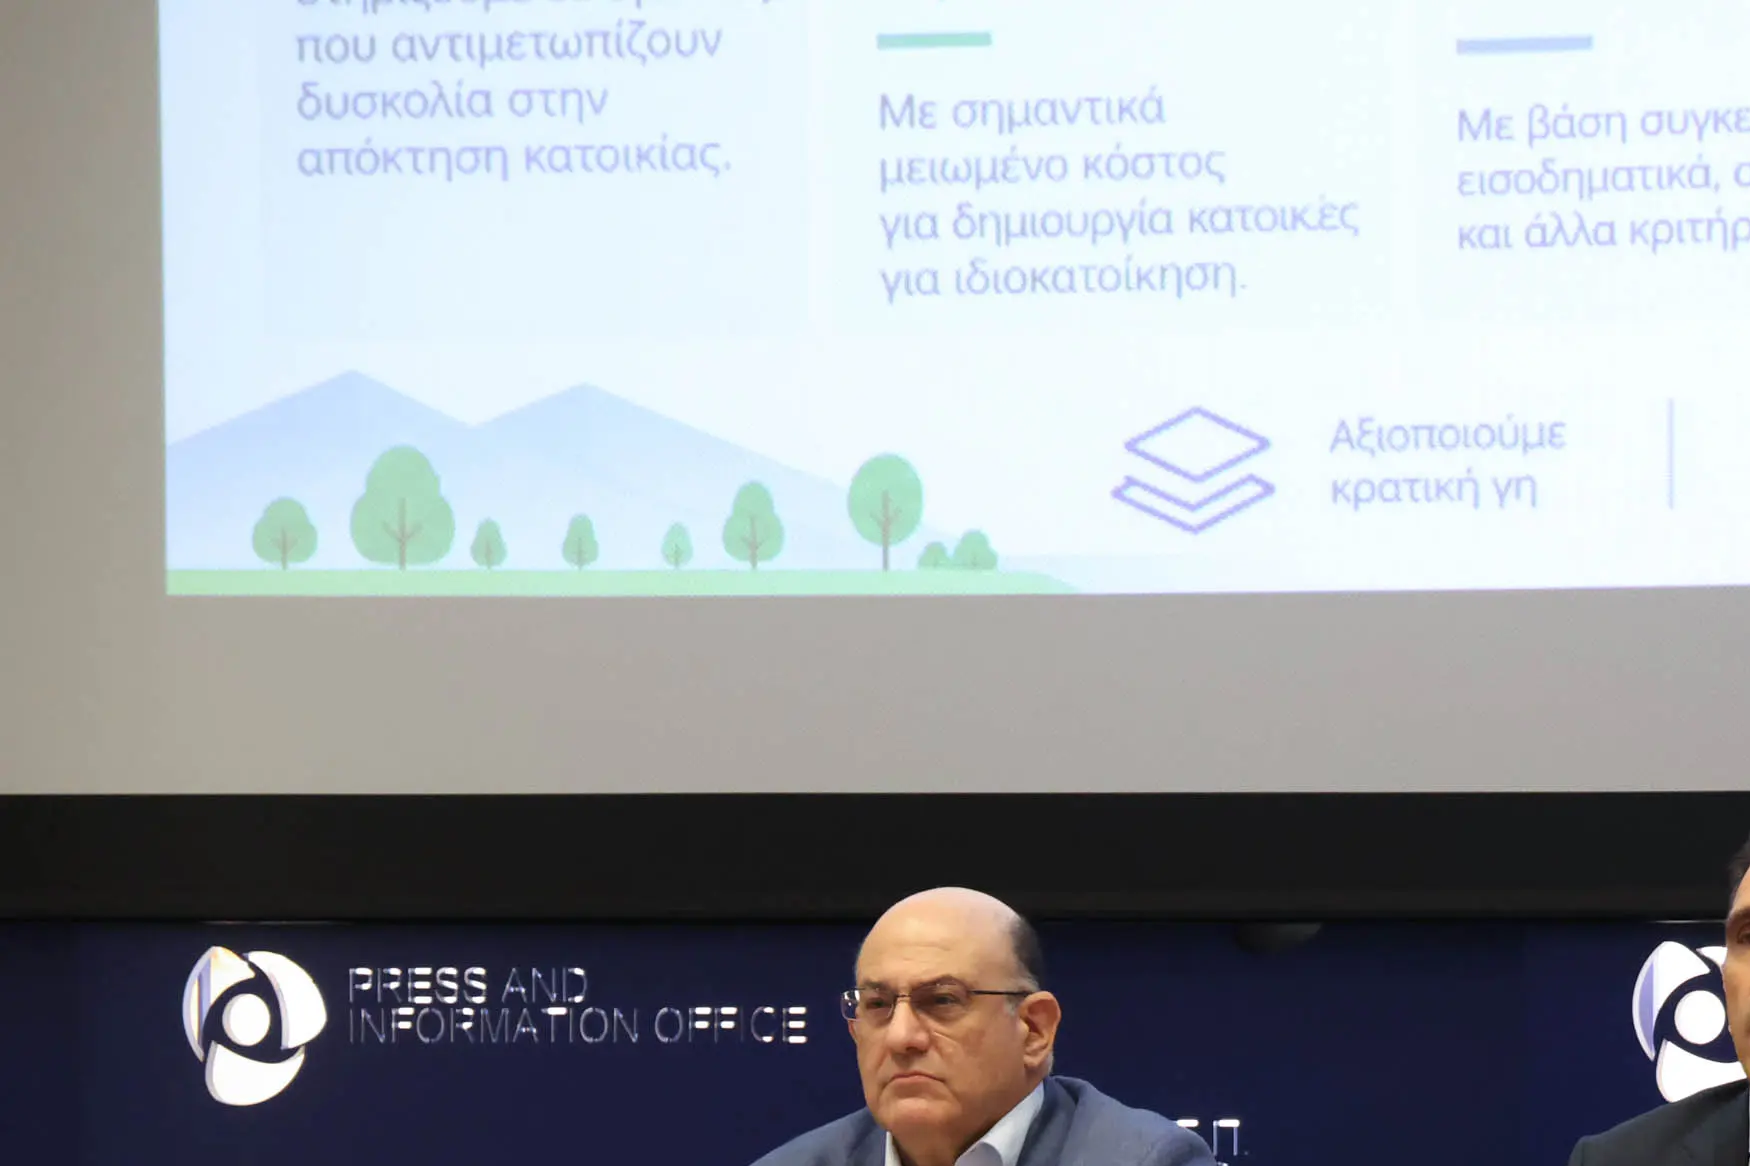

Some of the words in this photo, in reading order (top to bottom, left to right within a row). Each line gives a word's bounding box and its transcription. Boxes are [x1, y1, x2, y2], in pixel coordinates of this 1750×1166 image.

[296, 31, 377, 64] που
[391, 20, 724, 69] αντιμετωπίζουν
[296, 80, 495, 122] δυσκολία
[507, 85, 610, 122] στην
[879, 93, 938, 130] Με
[951, 85, 1166, 135] σημαντικά
[1457, 107, 1515, 143] Με
[1527, 103, 1628, 149] βάση
[296, 136, 510, 182] απόκτηση
[524, 132, 733, 176] κατοικίας.
[880, 145, 1069, 192] μειωμένο
[1082, 142, 1227, 184] κόστος
[1457, 155, 1722, 200] εισοδηματικά,
[880, 210, 940, 249] για
[952, 197, 1174, 247] δημιουργία
[1457, 219, 1513, 251] και
[1524, 211, 1617, 249] άλλα
[880, 266, 941, 305] για
[954, 255, 1248, 300] ιδιοκατοίκηση.
[1329, 413, 1567, 456] Αξιοποιούμε
[1331, 467, 1480, 510] κρατική
[1491, 474, 1538, 508] γη
[348, 966, 488, 1004] PRESS
[501, 967, 589, 1004] AND
[348, 1006, 641, 1044] INFORMATION
[654, 1006, 808, 1044] OFFICE
